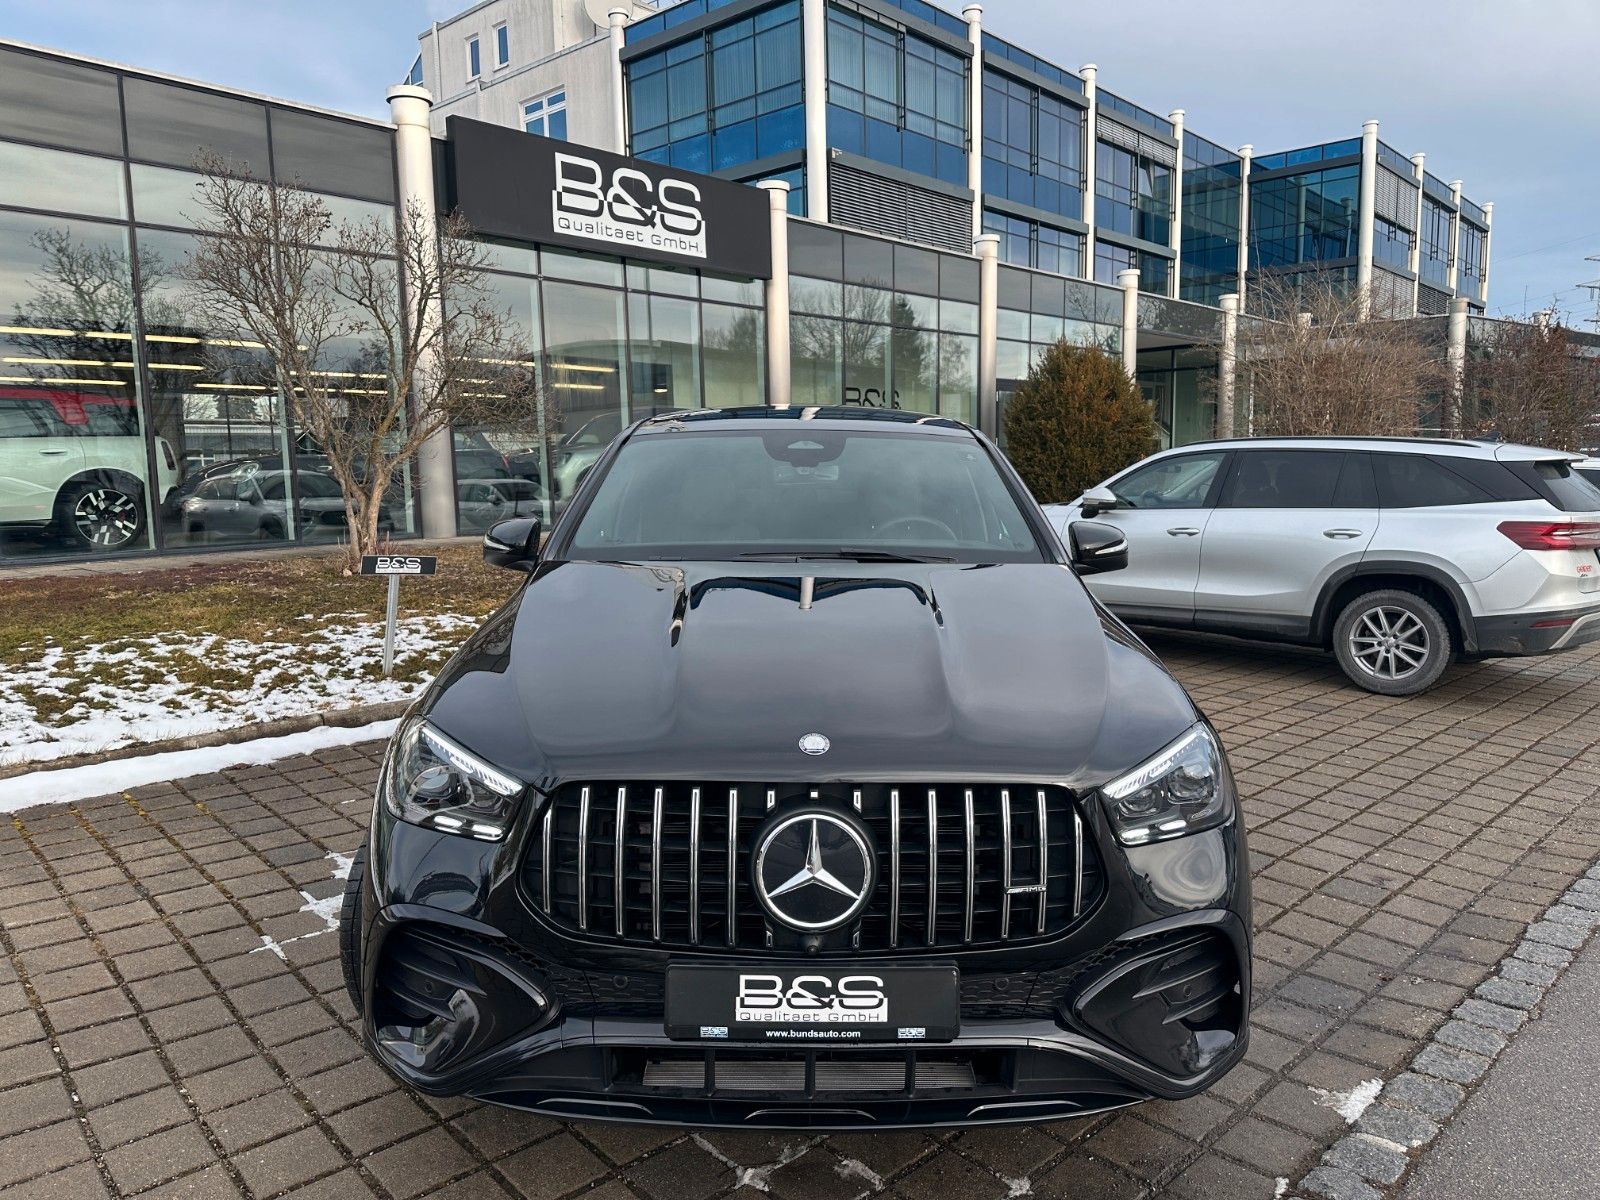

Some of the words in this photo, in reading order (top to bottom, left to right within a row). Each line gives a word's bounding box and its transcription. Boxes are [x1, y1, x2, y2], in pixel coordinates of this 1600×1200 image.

[555, 152, 702, 236] B&S
[558, 217, 644, 242] Qualitaet
[377, 557, 420, 569] B&S
[739, 975, 885, 1010] B&S
[740, 1011, 820, 1021] Qualitaet
[765, 1030, 861, 1039] www.bundsauto.com
